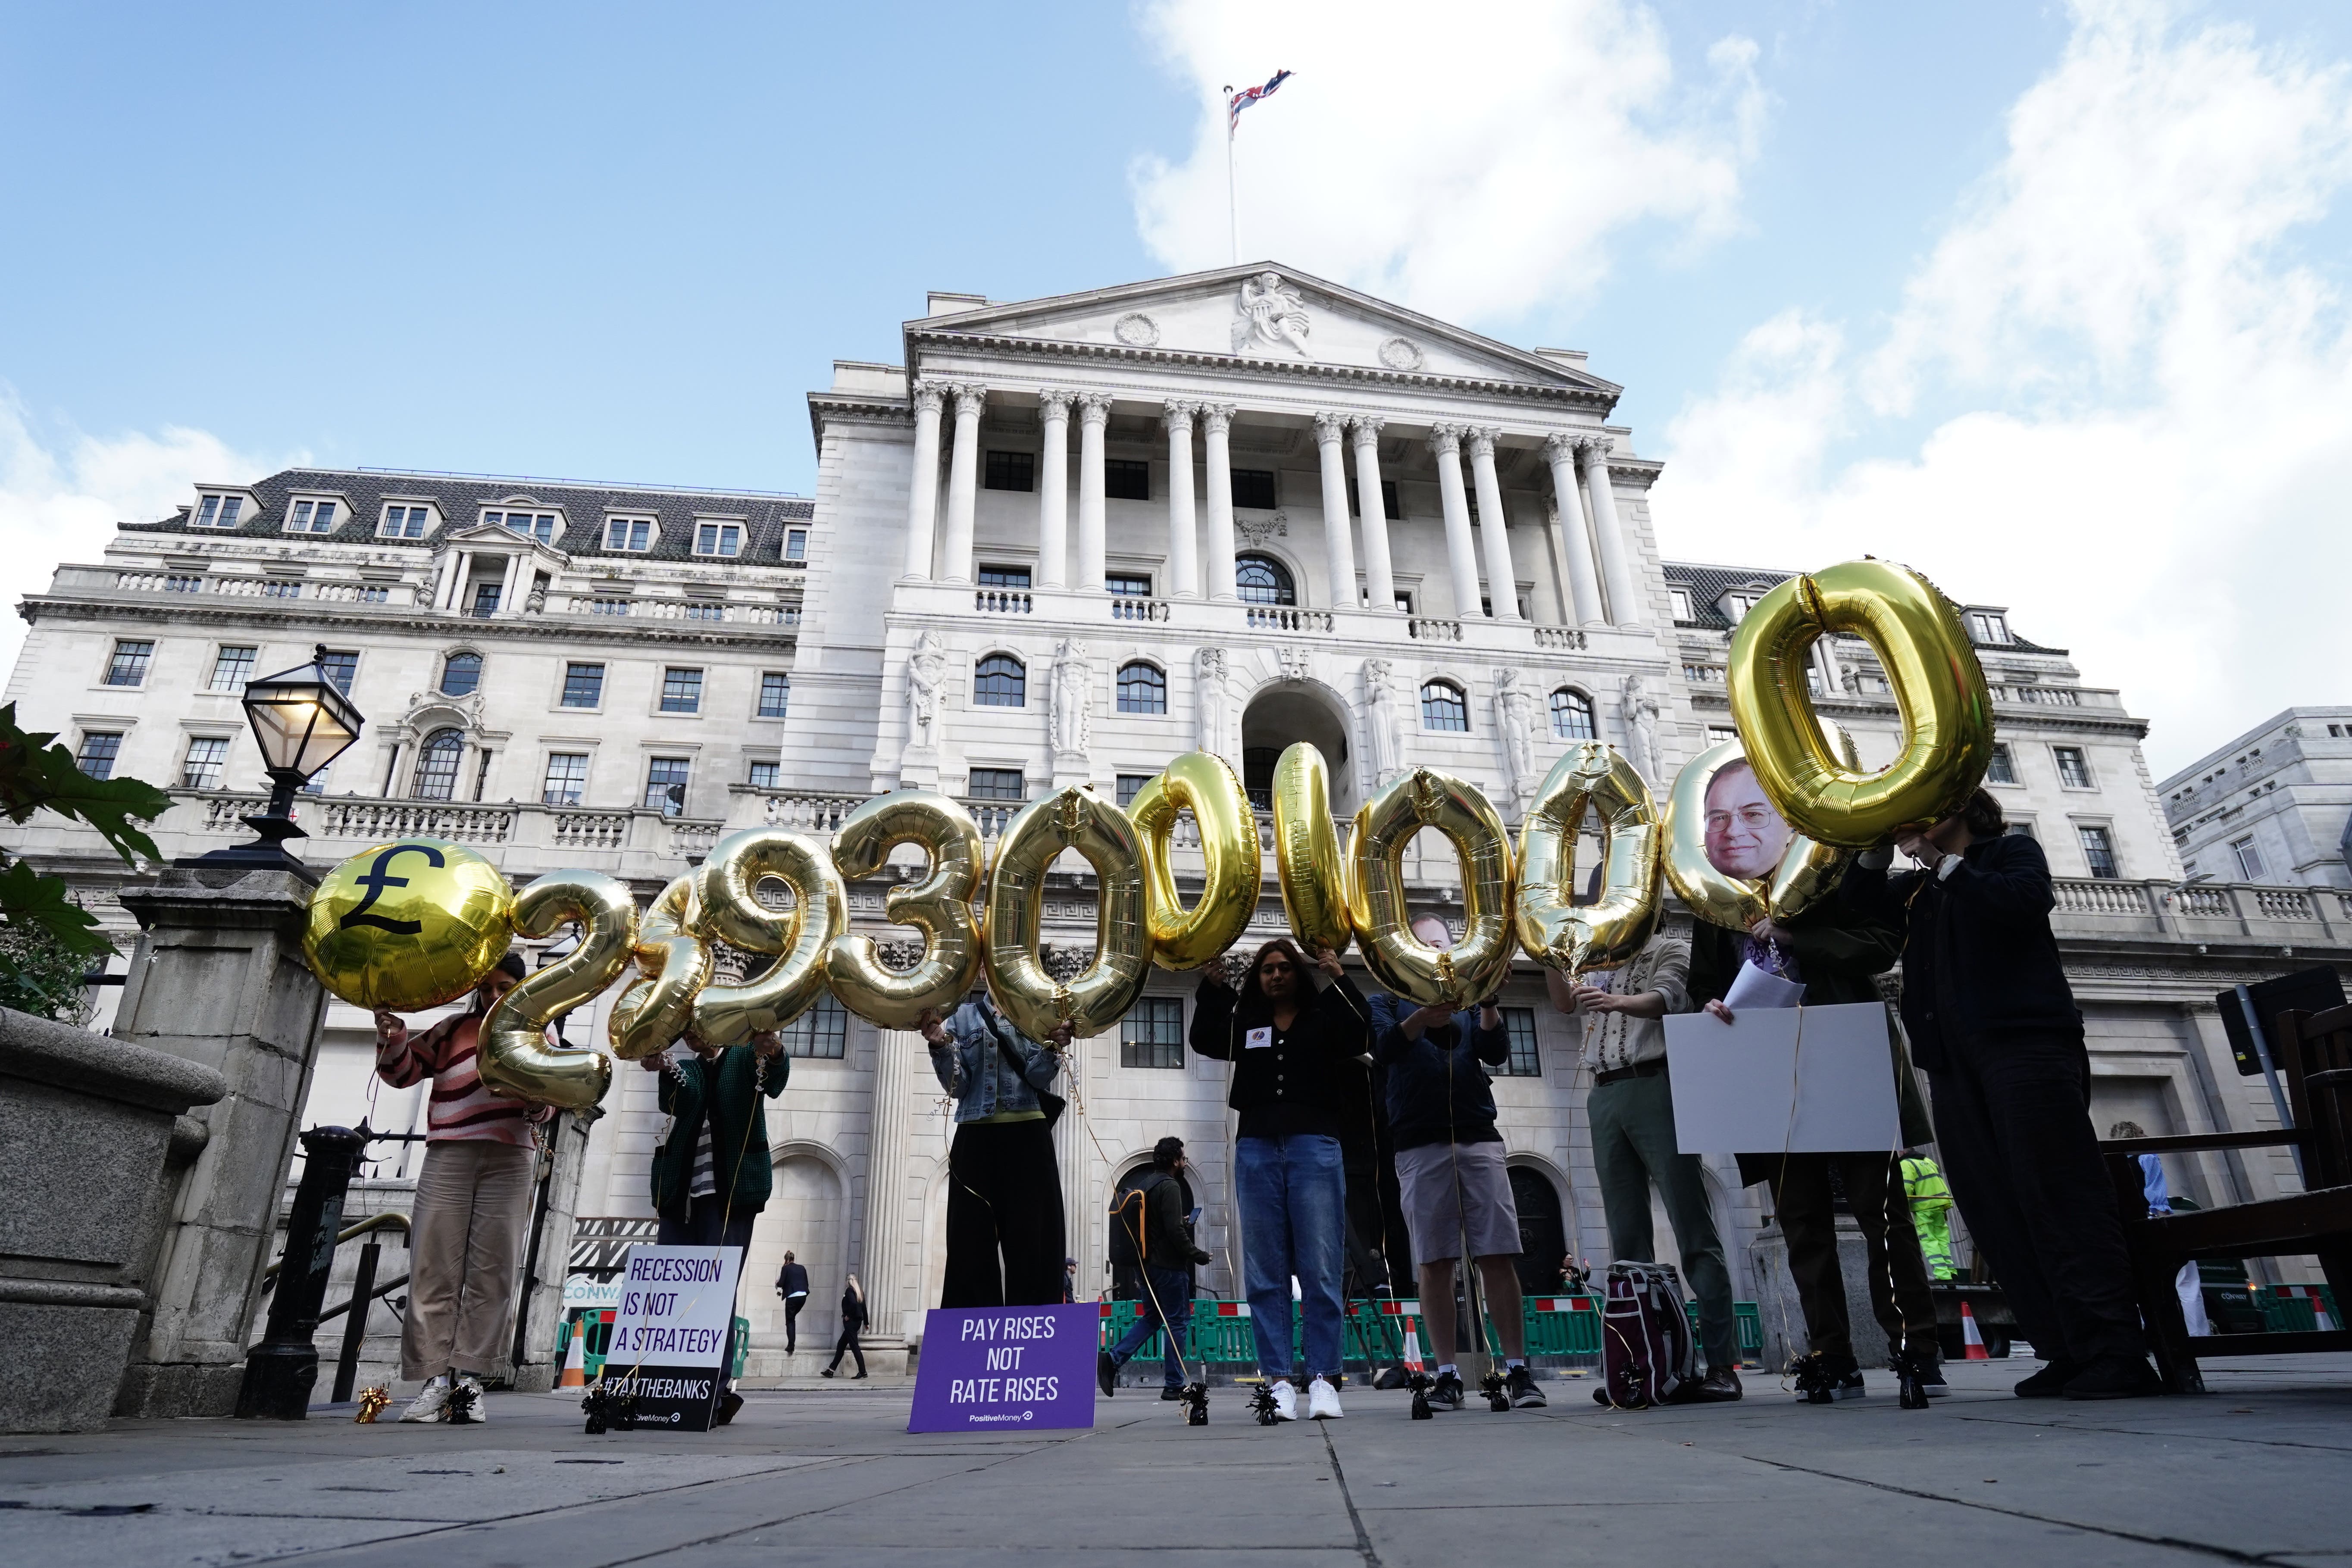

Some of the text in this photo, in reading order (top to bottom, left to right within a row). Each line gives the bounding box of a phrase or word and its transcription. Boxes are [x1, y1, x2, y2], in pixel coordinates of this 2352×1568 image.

[630, 1258, 723, 1282] RECESSION
[623, 1292, 678, 1316] IS NOT
[615, 1327, 723, 1353] A STRATEGY
[961, 1316, 1056, 1341] PAY RISES
[986, 1347, 1024, 1371] NOT
[604, 1377, 711, 1399] #TAXTHEBANKS
[950, 1377, 1059, 1403] RATE RISES
[969, 1414, 1022, 1422] PositiveMoney
